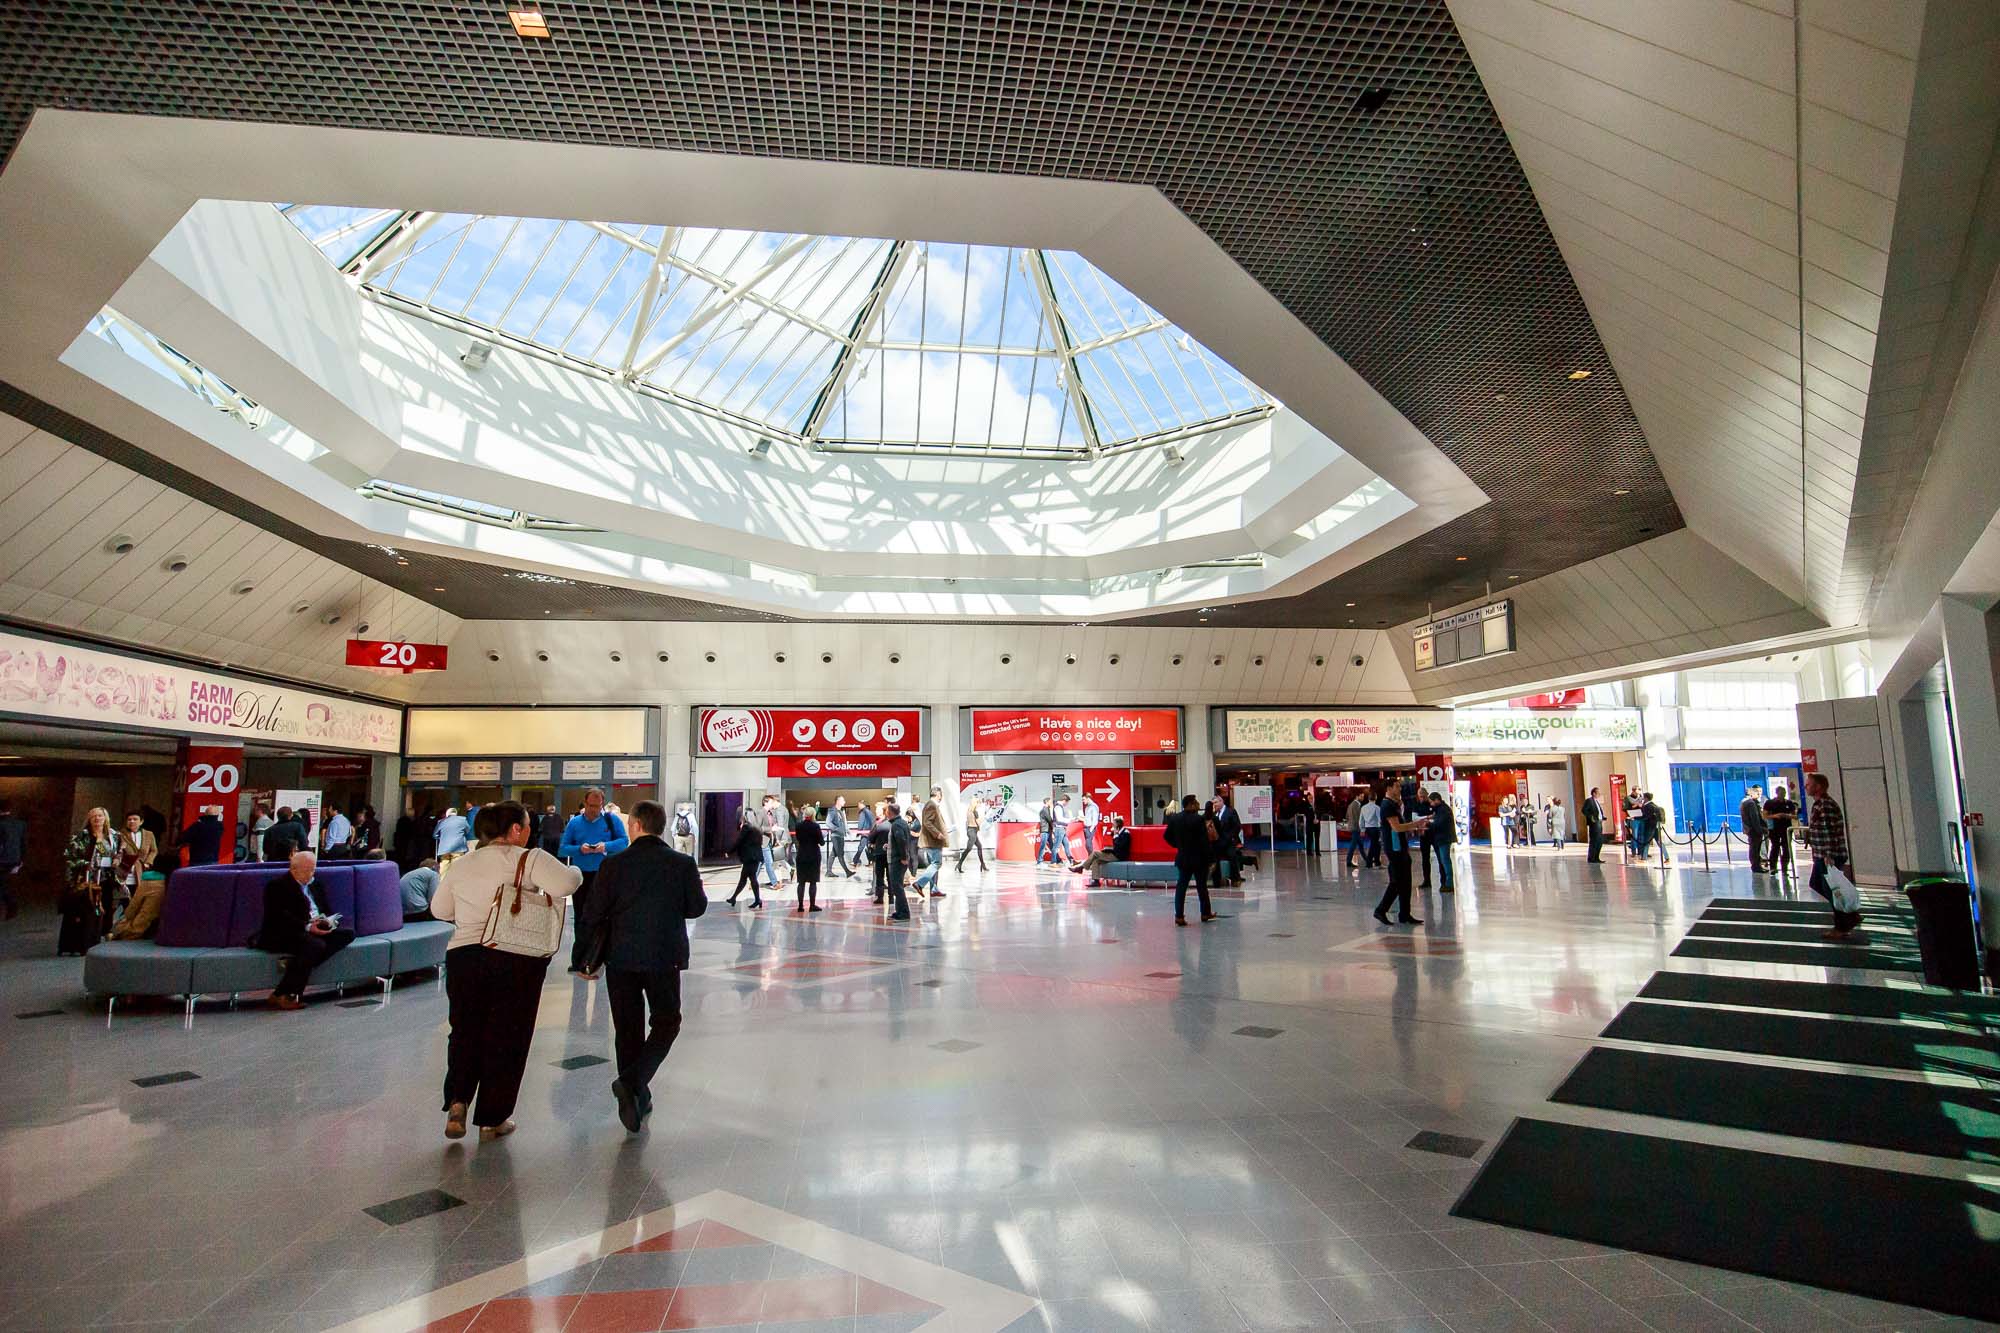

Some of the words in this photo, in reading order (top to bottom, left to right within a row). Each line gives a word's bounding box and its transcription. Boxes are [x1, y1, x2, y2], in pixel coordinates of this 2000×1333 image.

[1458, 616, 1467, 624] Hall
[1468, 613, 1474, 621] 17
[1485, 607, 1495, 616] Hall
[379, 643, 416, 666] 20
[190, 680, 233, 706] FARM
[1545, 691, 1566, 704] 19
[188, 702, 232, 725] SHOP
[228, 690, 282, 732] Deli
[277, 719, 299, 734] SHOW
[712, 717, 735, 731] nec
[979, 725, 1012, 736] connected
[1012, 722, 1031, 730] venue
[1040, 717, 1072, 729] Have
[1075, 719, 1083, 729] a
[1087, 716, 1111, 729] nice
[1115, 715, 1142, 732] day!
[1336, 726, 1379, 734] CONVENIENCE
[1493, 717, 1596, 729] FORECOURT
[719, 723, 749, 742] WiFi
[1337, 734, 1356, 742] SHOW
[1493, 729, 1544, 741] SHOW
[825, 760, 877, 771] Cloakroom
[188, 763, 239, 794] 20
[1417, 766, 1444, 782] 19
